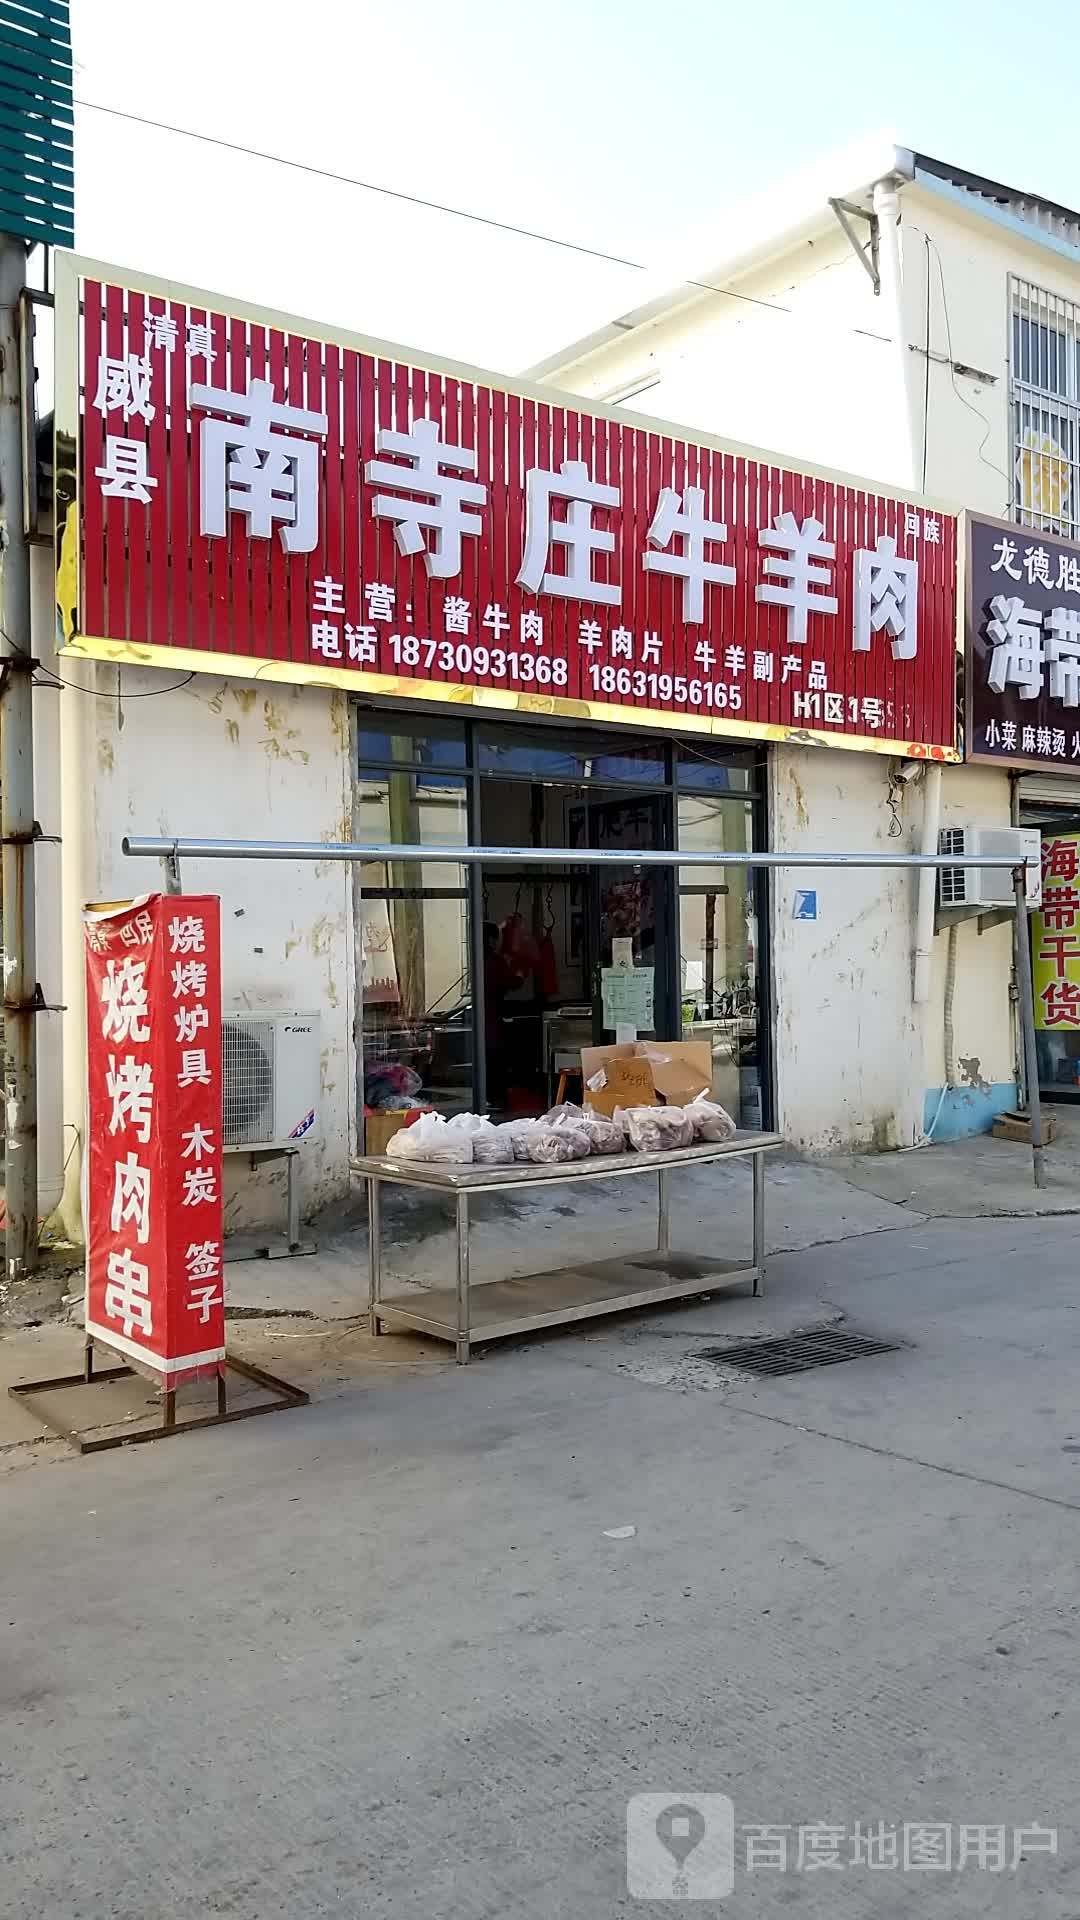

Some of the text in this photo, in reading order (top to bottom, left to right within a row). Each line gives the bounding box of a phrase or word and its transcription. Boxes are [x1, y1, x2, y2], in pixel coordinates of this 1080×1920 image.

[142, 312, 217, 362] 清真
[92, 353, 158, 504] 威县
[188, 376, 918, 661] 南寺庄牛羊肉
[905, 512, 940, 545] 回族
[311, 619, 742, 710] 电话 18730931368 18631956165
[577, 619, 663, 665] 羊肉片
[694, 640, 828, 691] 牛羊副产品
[985, 718, 1017, 751] 小菜
[1021, 725, 1066, 758] 麻辣烫
[1040, 840, 1080, 1026] 海带干货
[102, 957, 154, 1338] 烧烤肉串
[168, 915, 223, 1324] 烧烤炉具 木炭 签子
